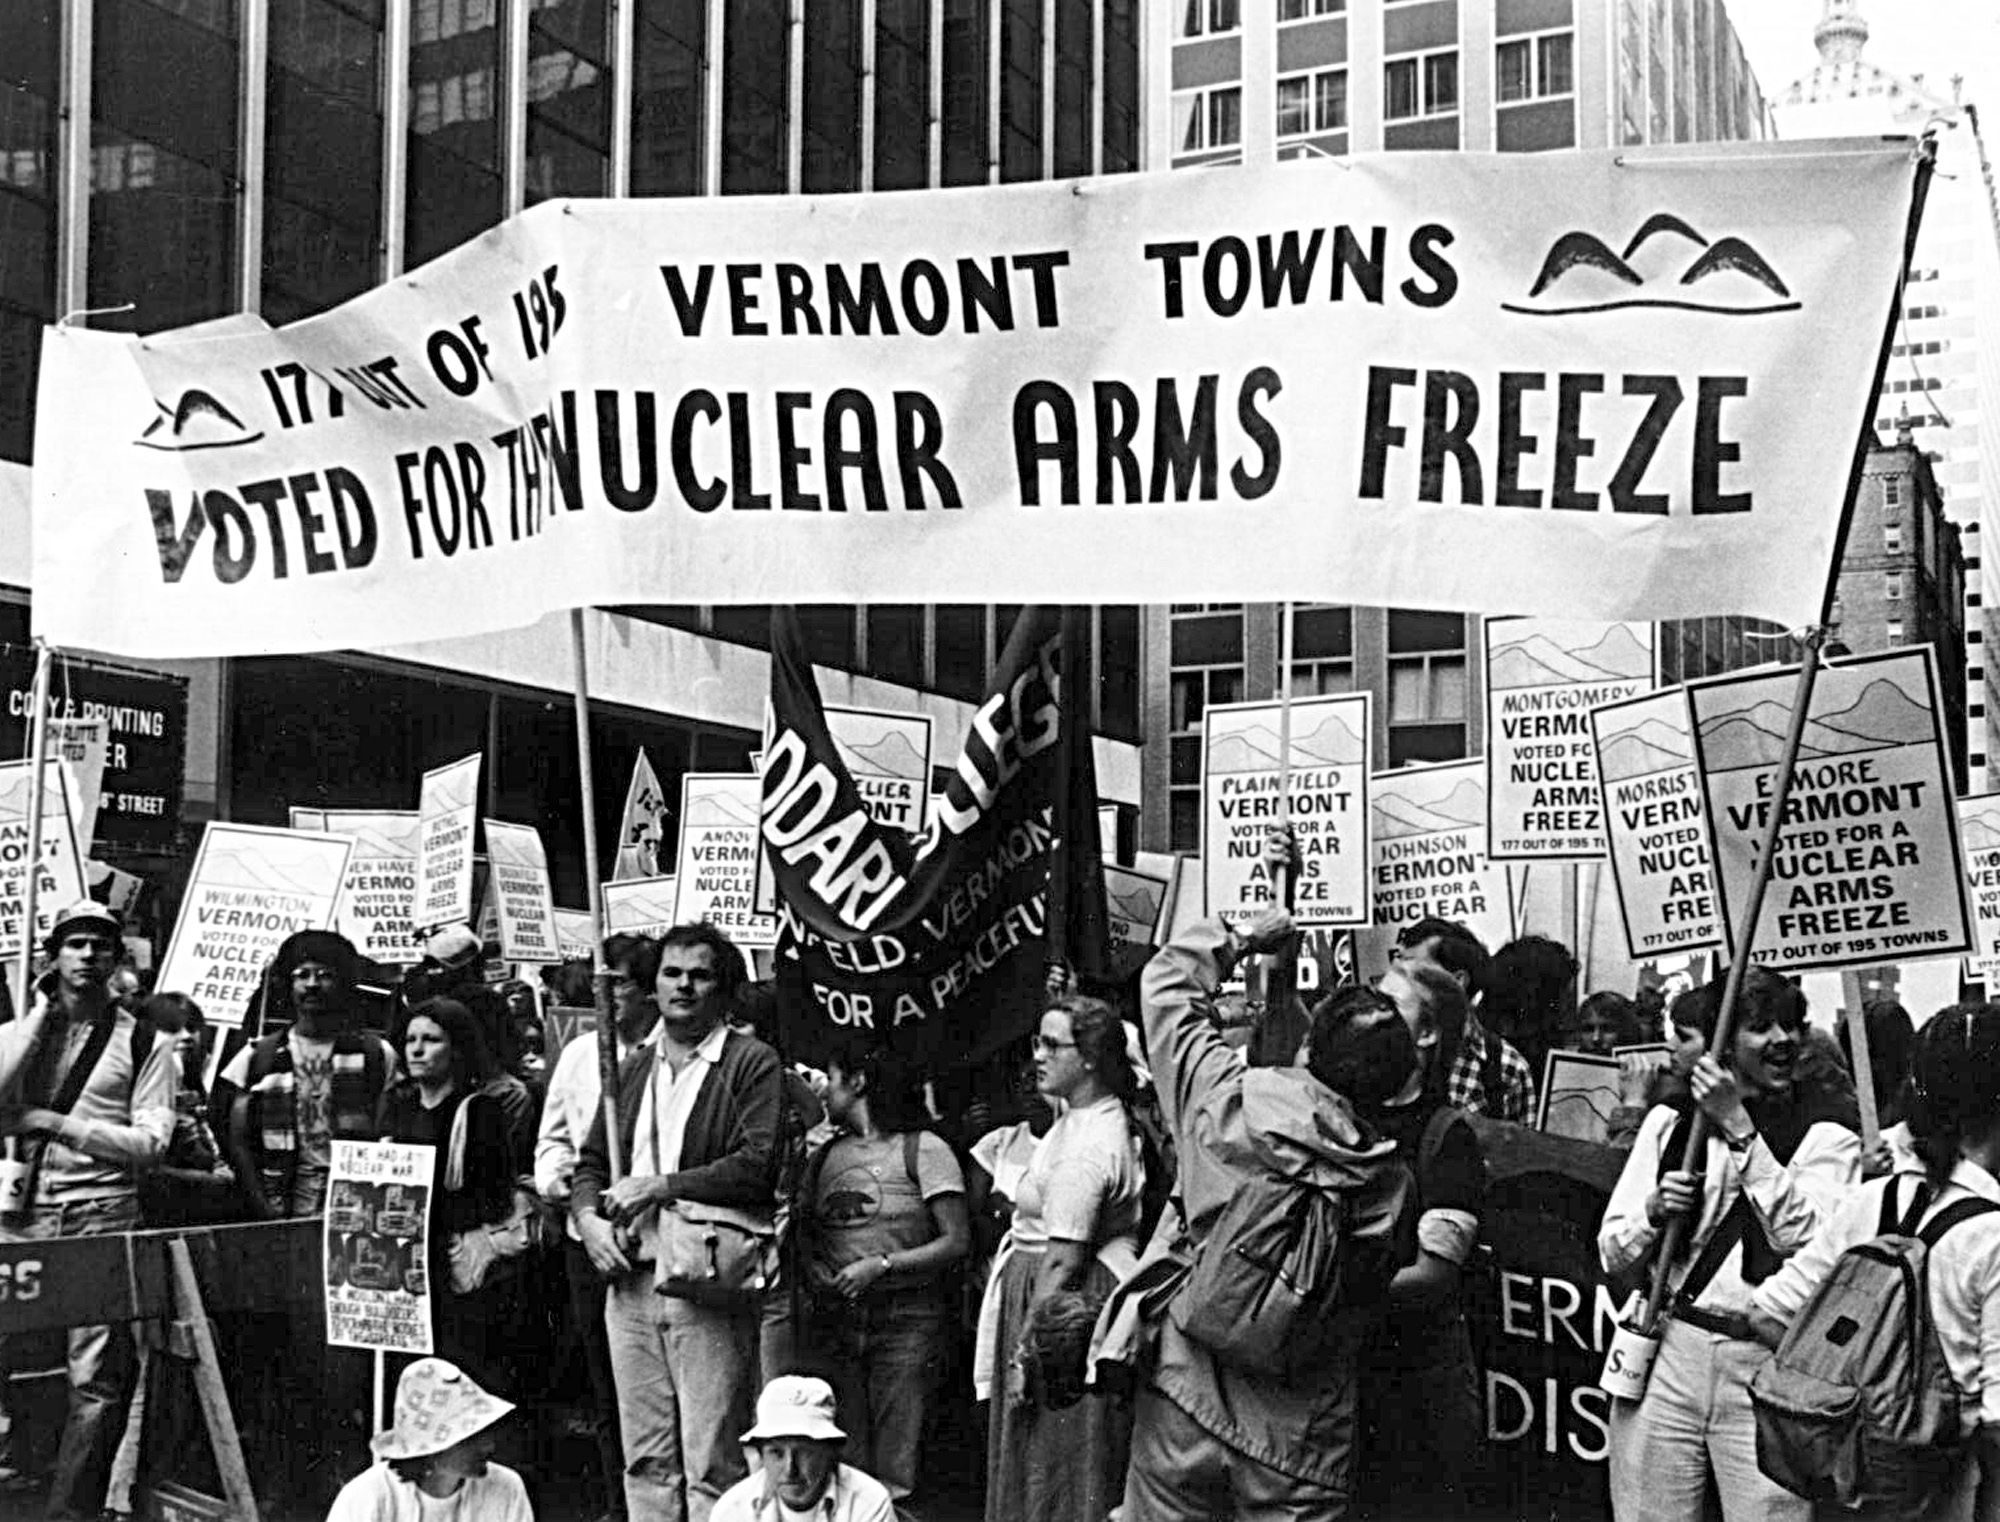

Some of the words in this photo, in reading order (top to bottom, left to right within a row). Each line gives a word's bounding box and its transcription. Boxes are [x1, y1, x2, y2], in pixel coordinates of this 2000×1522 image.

[426, 315, 495, 398] OF
[660, 251, 1069, 337] VERMONT
[1144, 223, 1458, 317] TOWNS
[145, 467, 378, 584] VOTED
[395, 442, 493, 559] FOR
[549, 388, 963, 515] NUCLEAR
[1013, 366, 1282, 507] ARMS
[1358, 365, 1753, 517] FREEZE
[9, 690, 60, 719] COY
[1514, 744, 1565, 760] VOTED
[1511, 761, 1596, 783] NUCLE
[1755, 759, 1880, 798] EMORE
[117, 794, 165, 815] STREET
[1231, 824, 1274, 837] VOTE
[1325, 820, 1336, 832] A
[1523, 810, 1600, 832] FREEZ
[424, 825, 469, 852] VERMONT
[1502, 840, 1519, 849] 177
[1522, 839, 1547, 849] OUT
[1550, 839, 1564, 848] OF
[1568, 838, 1588, 848] 195
[1639, 827, 1699, 851] VOTED
[1836, 823, 1884, 845] FOR
[1891, 820, 1909, 838] A
[691, 846, 754, 861] VERM
[1380, 834, 1467, 862] JOHNSON
[425, 858, 464, 879] NUCLEAR
[700, 866, 739, 876] VOTED
[1638, 845, 1709, 875] NUCL
[354, 894, 395, 903] VOTED
[500, 881, 544, 895] VERMONT
[1240, 882, 1328, 903] FRZE
[1373, 886, 1425, 904] VOTED
[1432, 883, 1463, 898] FOR
[1468, 881, 1481, 892] A
[1789, 875, 1894, 909] ARMS
[426, 891, 457, 909] FREEZE
[1373, 895, 1487, 926] NUCLEAR
[1661, 896, 1717, 924] FRE
[198, 907, 316, 932] VERMONT
[353, 905, 412, 918] NUCLE
[506, 907, 545, 920] NUCLEAR
[703, 912, 770, 926] FREEZE
[1307, 906, 1353, 917] TOWNS
[1778, 902, 1911, 938] FREEZE
[202, 930, 248, 944] VOTED
[252, 936, 280, 947] FOR
[514, 934, 546, 947] FREEZE
[1643, 933, 1663, 946] 177
[1666, 928, 1694, 943] OUT
[1697, 924, 1714, 938] OF
[1751, 948, 1779, 963] 177
[1782, 944, 1817, 960] OUT
[1821, 941, 1844, 956] OF
[1847, 938, 1877, 952] 195
[1881, 929, 1950, 949] TOWNS
[812, 982, 875, 1029] FOR
[893, 993, 926, 1027] A
[931, 893, 1046, 1009] PEACEFU
[205, 965, 258, 983] ARM
[191, 982, 254, 1002] FREE
